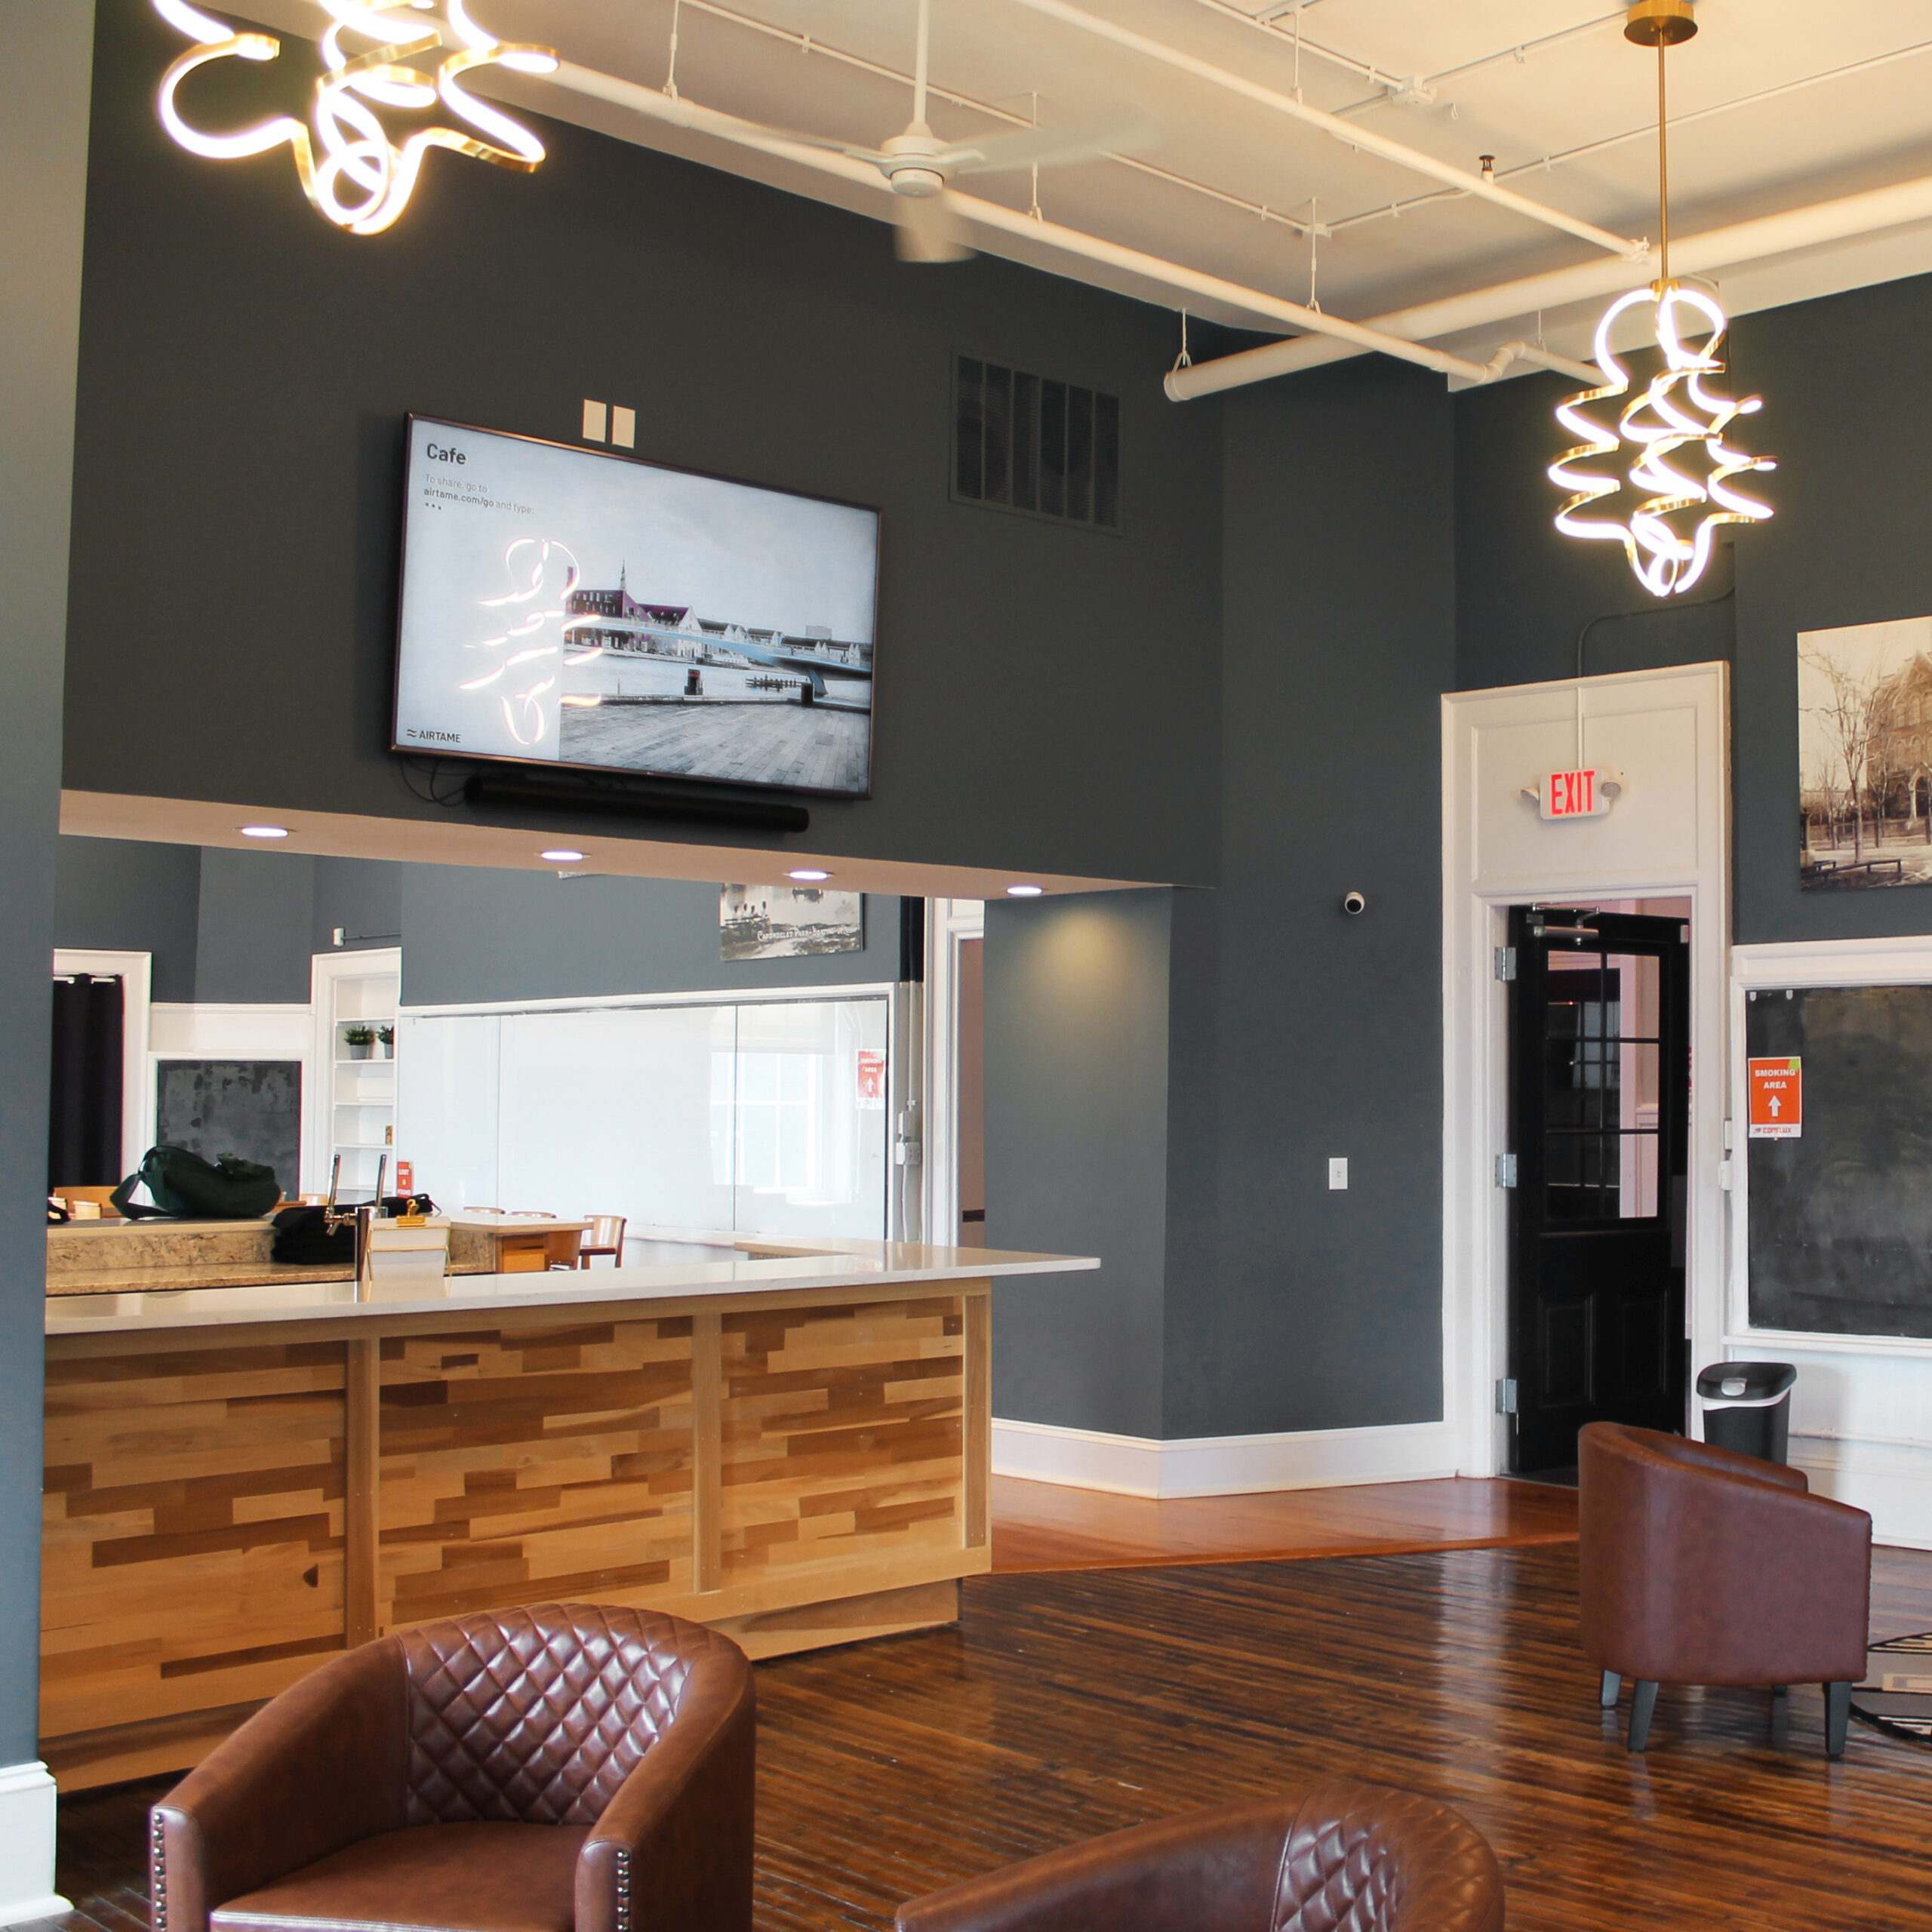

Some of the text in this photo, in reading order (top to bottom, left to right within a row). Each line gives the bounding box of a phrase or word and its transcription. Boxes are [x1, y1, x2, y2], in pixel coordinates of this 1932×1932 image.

[426, 443, 466, 465] Cafe
[425, 473, 435, 484] To
[466, 483, 477, 492] go
[478, 485, 488, 493] to
[423, 487, 494, 508] airtame.com/go
[495, 500, 512, 510] and
[419, 730, 462, 743] AIRTAME
[1551, 770, 1595, 815] EXIT
[1755, 1069, 1796, 1077] SMOKING
[1763, 1081, 1787, 1089] AREA
